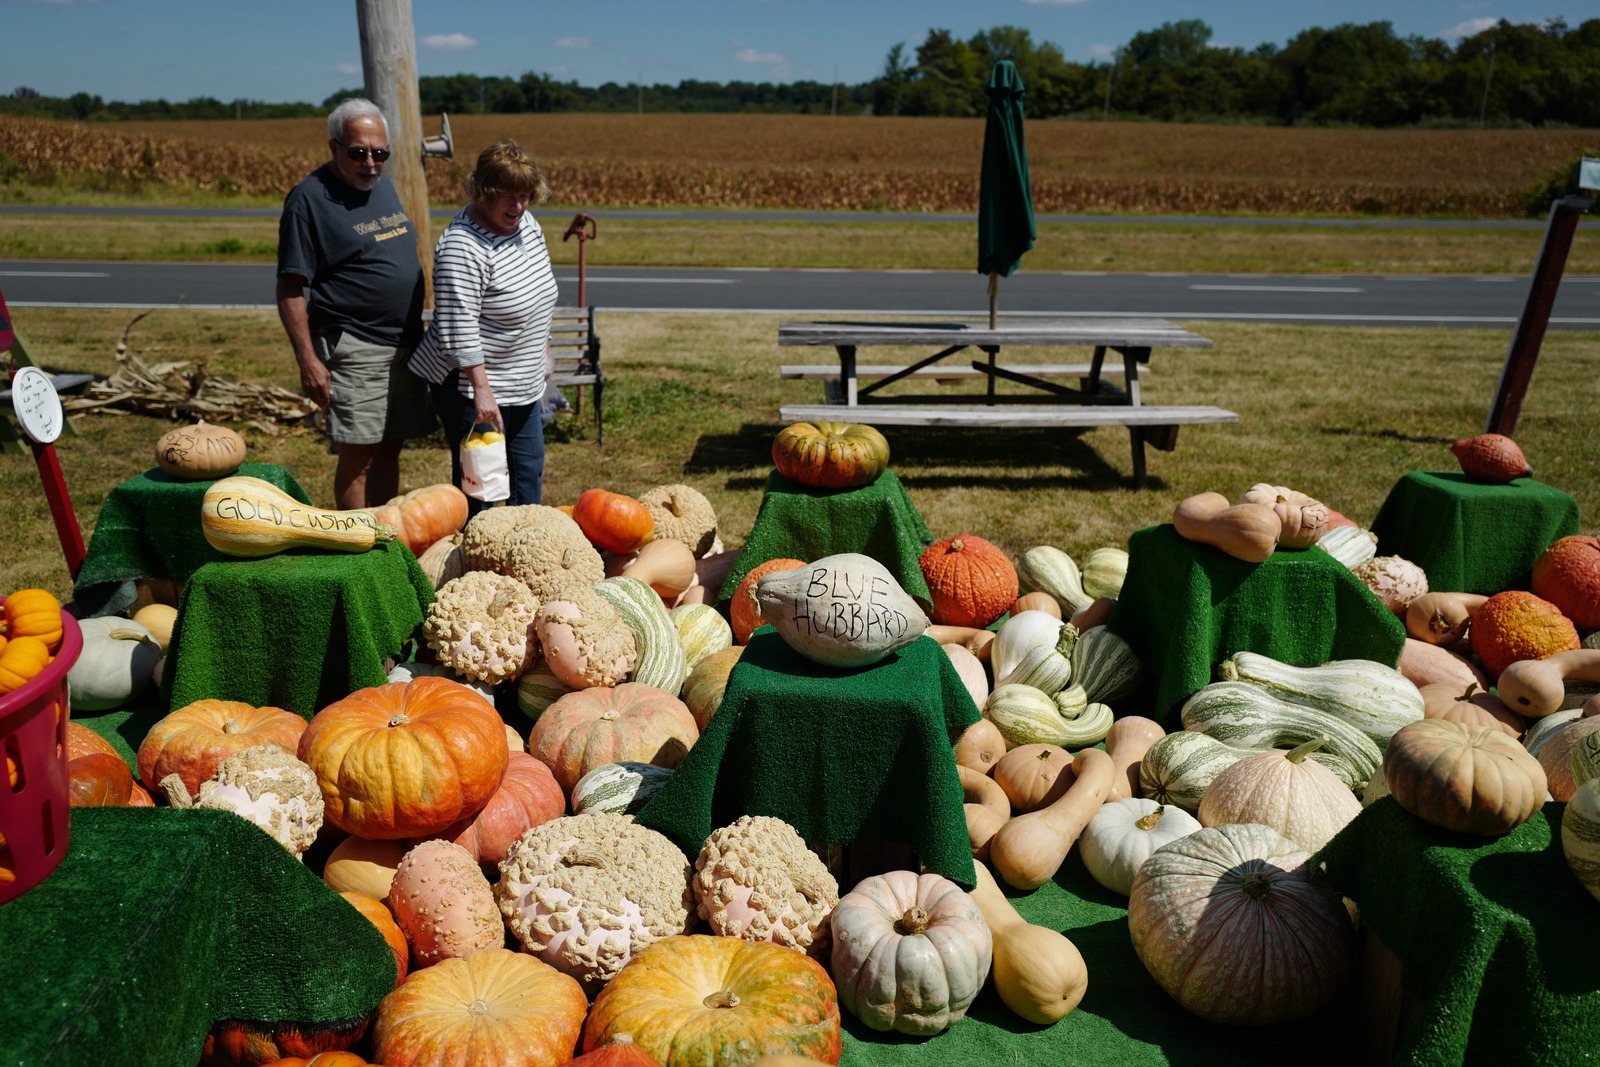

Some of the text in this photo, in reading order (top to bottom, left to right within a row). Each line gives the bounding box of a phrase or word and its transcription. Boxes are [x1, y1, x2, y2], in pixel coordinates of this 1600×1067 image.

[353, 211, 408, 235] West Virgini
[783, 435, 877, 466] CINDERELL
[216, 497, 283, 526] GOLD
[807, 568, 889, 609] BLUE
[792, 598, 908, 642] HUBBARD
